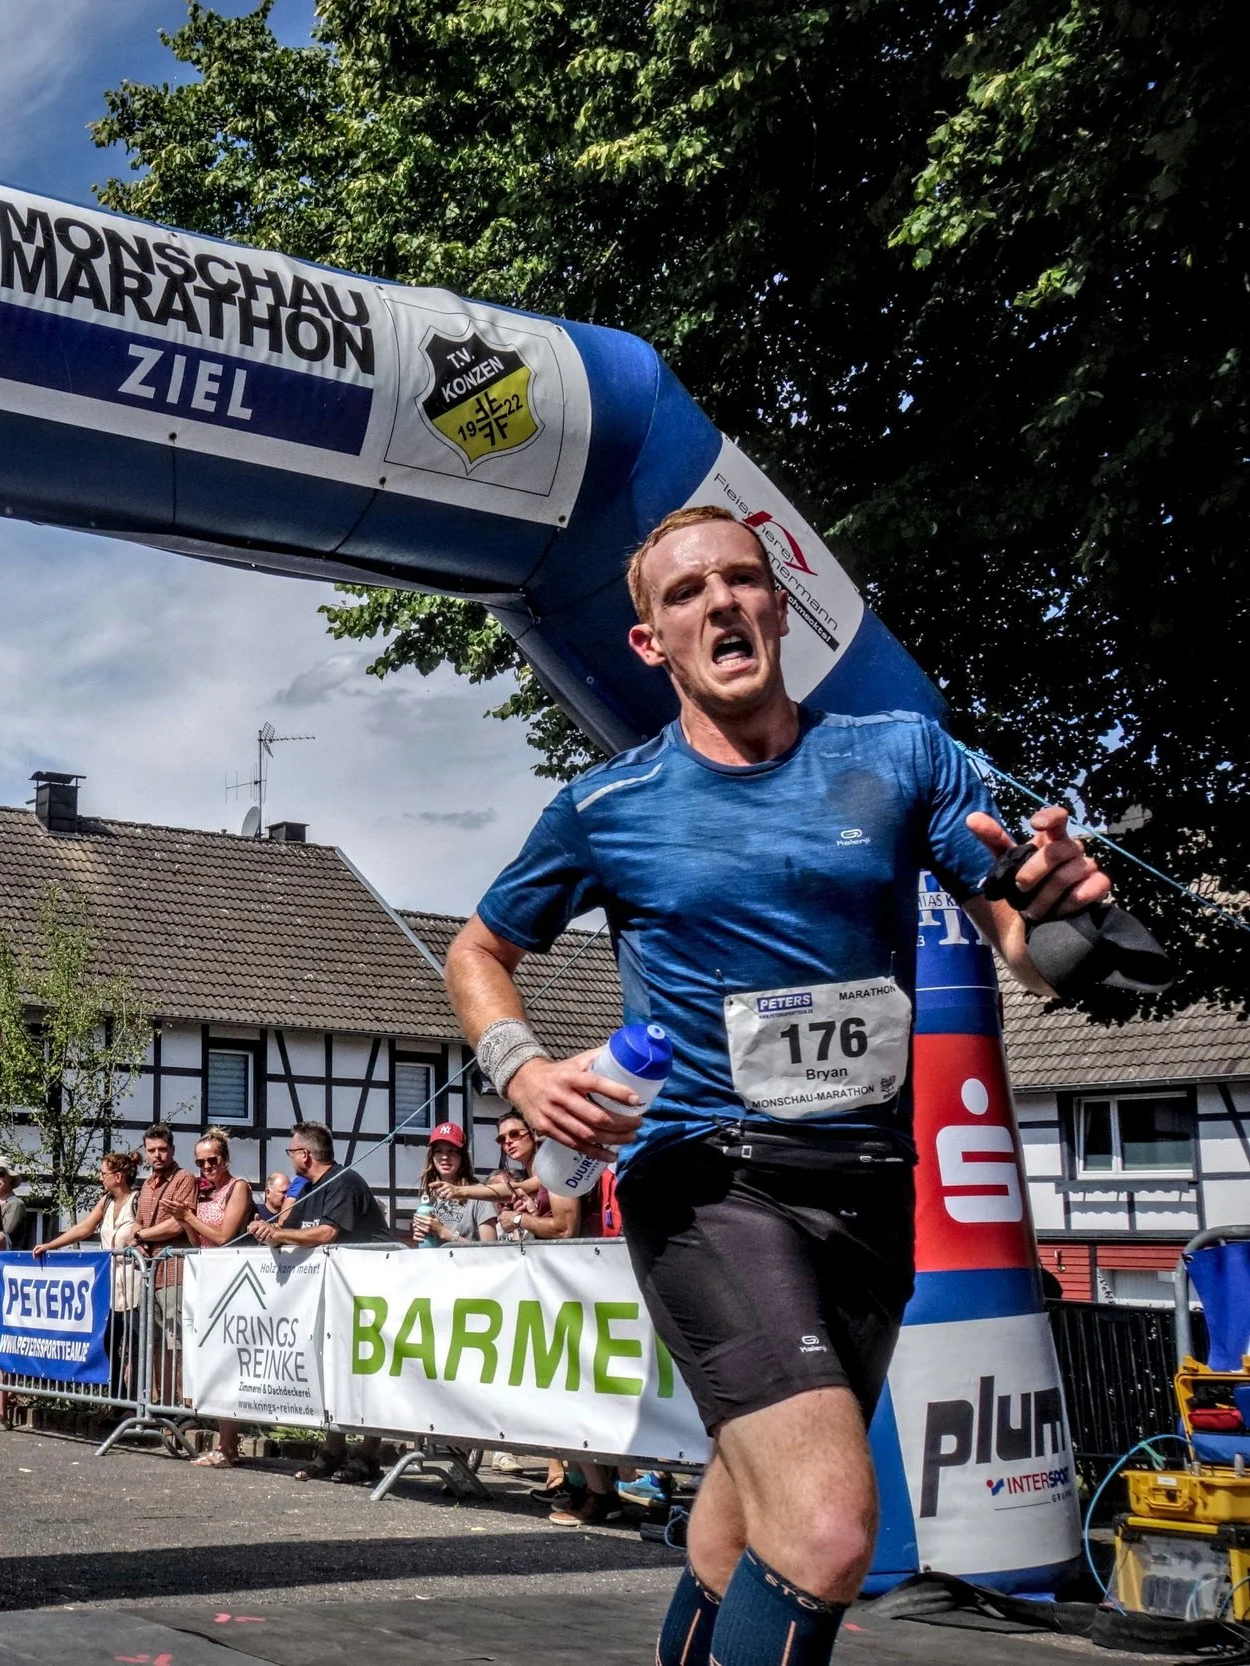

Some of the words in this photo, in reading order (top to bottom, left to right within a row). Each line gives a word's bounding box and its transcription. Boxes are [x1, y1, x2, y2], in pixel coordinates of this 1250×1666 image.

[1, 239, 375, 375] MARATHON
[447, 347, 475, 369] T.V.
[118, 344, 253, 420] ZIEL
[441, 356, 504, 402] KONZEN
[458, 421, 476, 441] 19
[504, 394, 523, 416] 22
[714, 473, 794, 562] Fleiserei
[767, 551, 838, 631] mermann
[786, 592, 831, 642] chmeckts!
[760, 995, 811, 1010] PETERS
[839, 985, 896, 1001] MARATHON
[781, 1017, 868, 1065] 176
[806, 1067, 848, 1081] Bryan
[752, 1084, 875, 1109] MONSCHAU-MARATHON
[260, 1262, 277, 1273] Holz
[297, 1263, 320, 1274] mehr!
[5, 1278, 89, 1321] PETERS
[223, 1312, 299, 1348] KRINGS
[237, 1347, 309, 1383] REINKE
[238, 1400, 315, 1416] www.krings-reinke.de
[268, 1385, 311, 1398] Dachdeckerei
